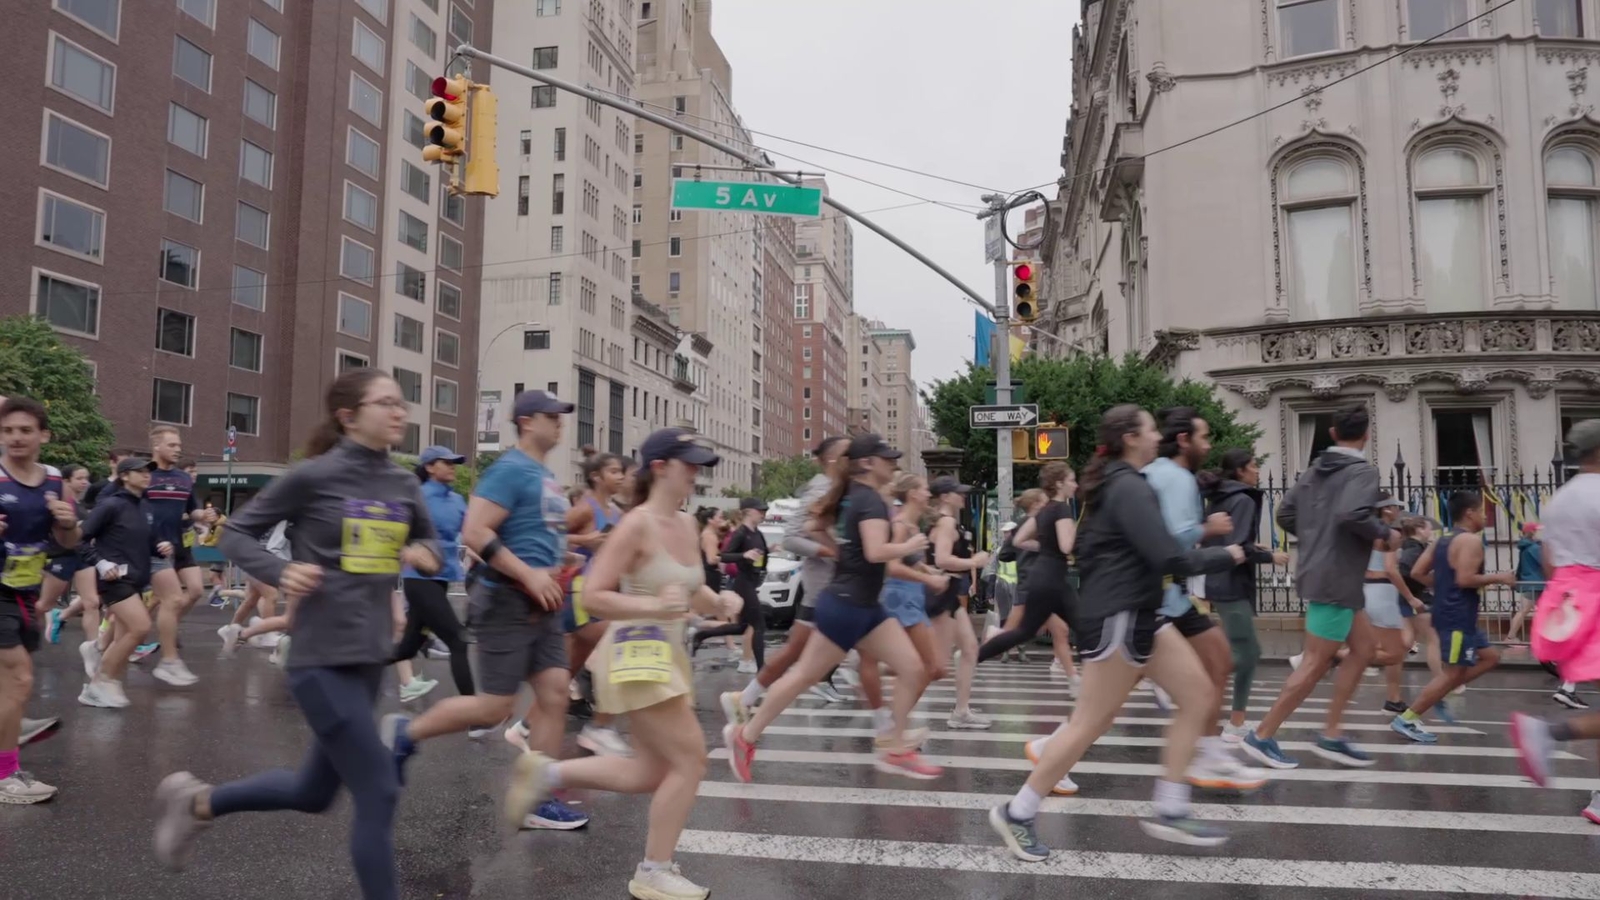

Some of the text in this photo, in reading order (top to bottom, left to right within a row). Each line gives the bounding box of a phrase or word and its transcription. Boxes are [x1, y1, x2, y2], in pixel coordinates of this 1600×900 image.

[715, 186, 777, 208] 5 Av
[976, 411, 1029, 421] ONE WAY
